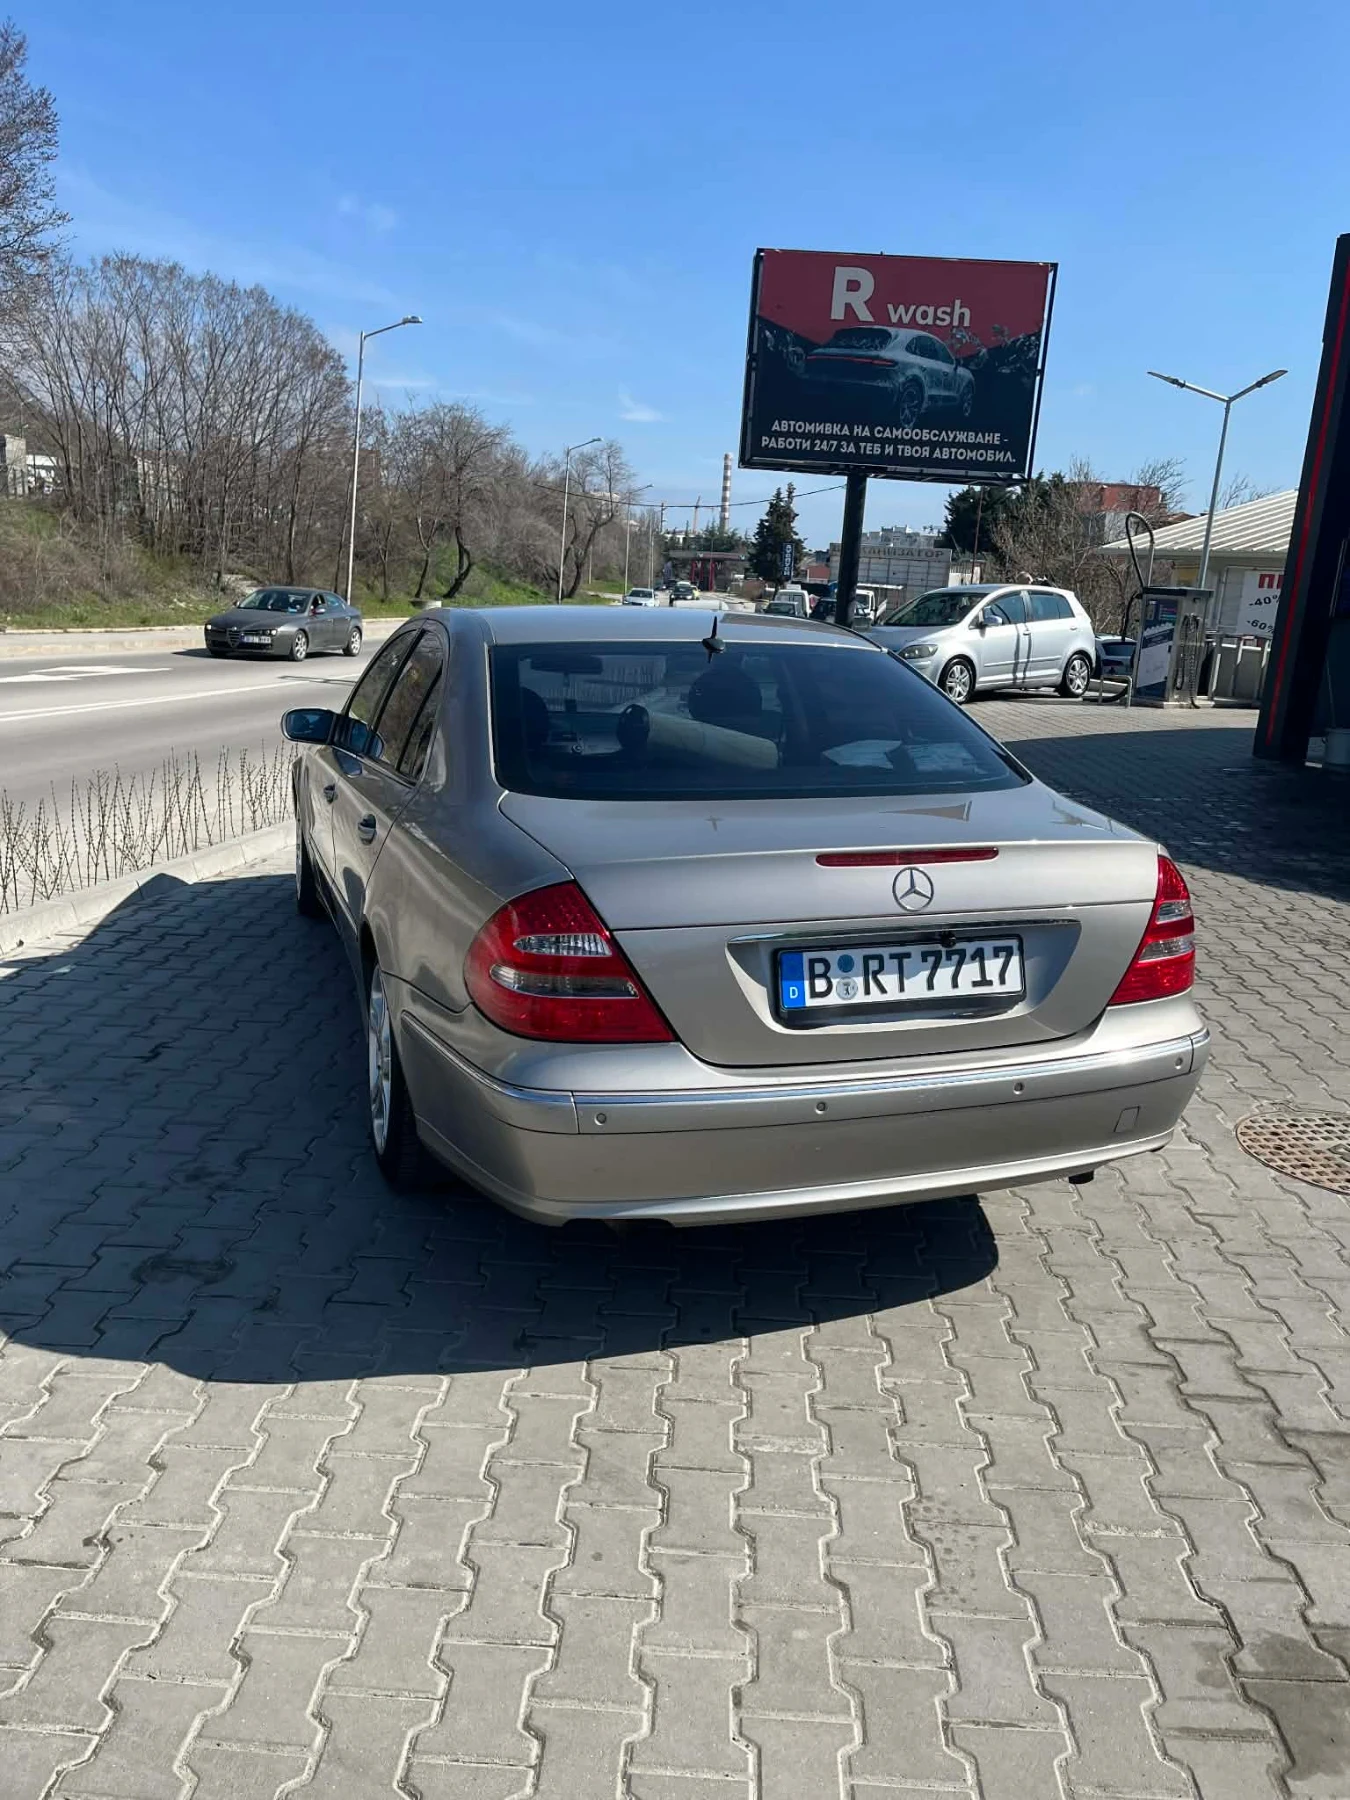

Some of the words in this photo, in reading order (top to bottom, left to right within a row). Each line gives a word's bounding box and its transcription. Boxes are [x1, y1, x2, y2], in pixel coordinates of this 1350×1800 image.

[830, 266, 875, 322] R
[887, 299, 971, 327] wash
[771, 420, 850, 436] АВТОМИВКА
[853, 425, 870, 437] НА
[874, 427, 1001, 444] САМООБСЛУЖВАНЕ
[761, 436, 811, 450] РАБОТИ
[814, 439, 838, 451] 24/7
[840, 442, 856, 453] ЗА
[859, 443, 881, 455] ТЕБ
[885, 444, 893, 456] И
[897, 445, 930, 458] ТВОЯ
[933, 447, 1017, 462] АВТОМОБИЛ.
[808, 957, 833, 998] B
[863, 952, 912, 995] RT
[921, 945, 1013, 991] 7717
[789, 986, 799, 999] D
